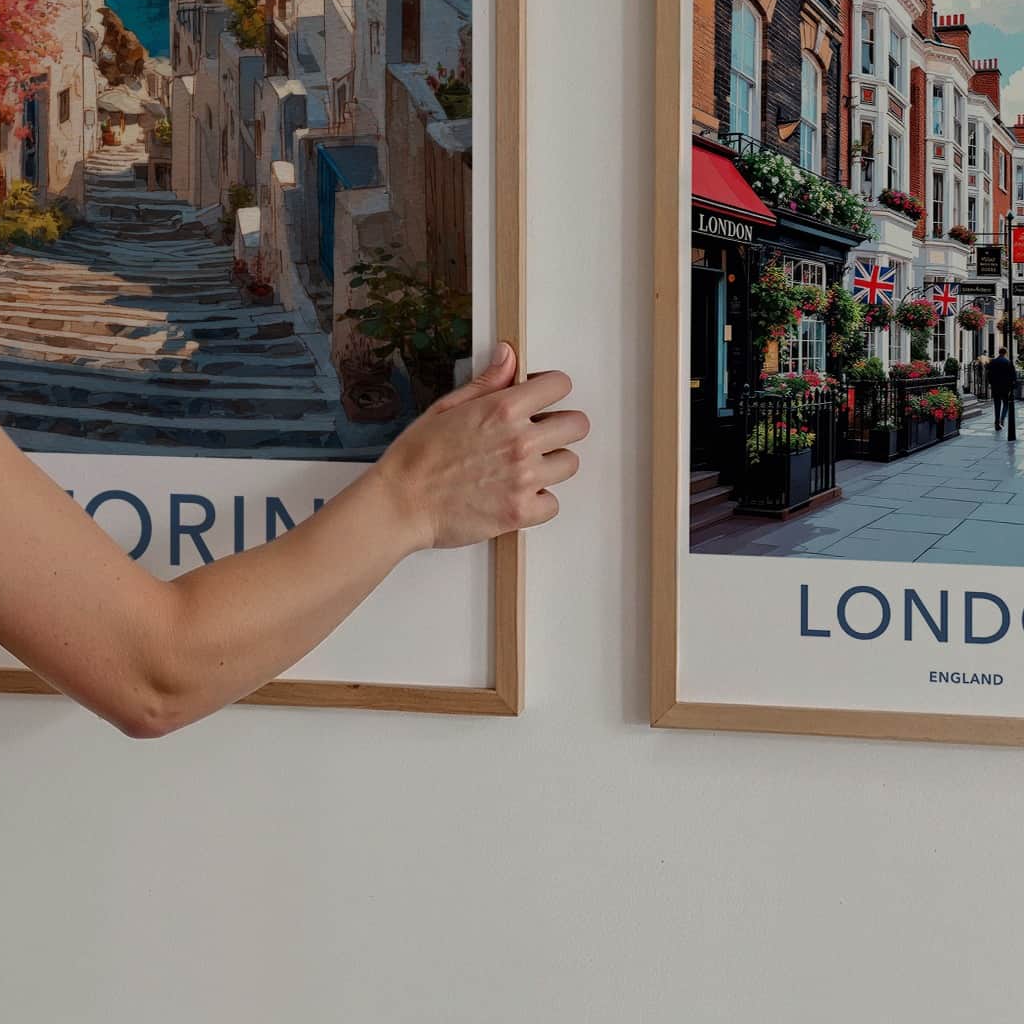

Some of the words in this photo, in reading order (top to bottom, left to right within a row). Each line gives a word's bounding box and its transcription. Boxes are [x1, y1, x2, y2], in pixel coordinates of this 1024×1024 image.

[698, 213, 753, 242] LONDON
[800, 583, 1024, 645] LOND
[929, 670, 1004, 686] ENGLAND
